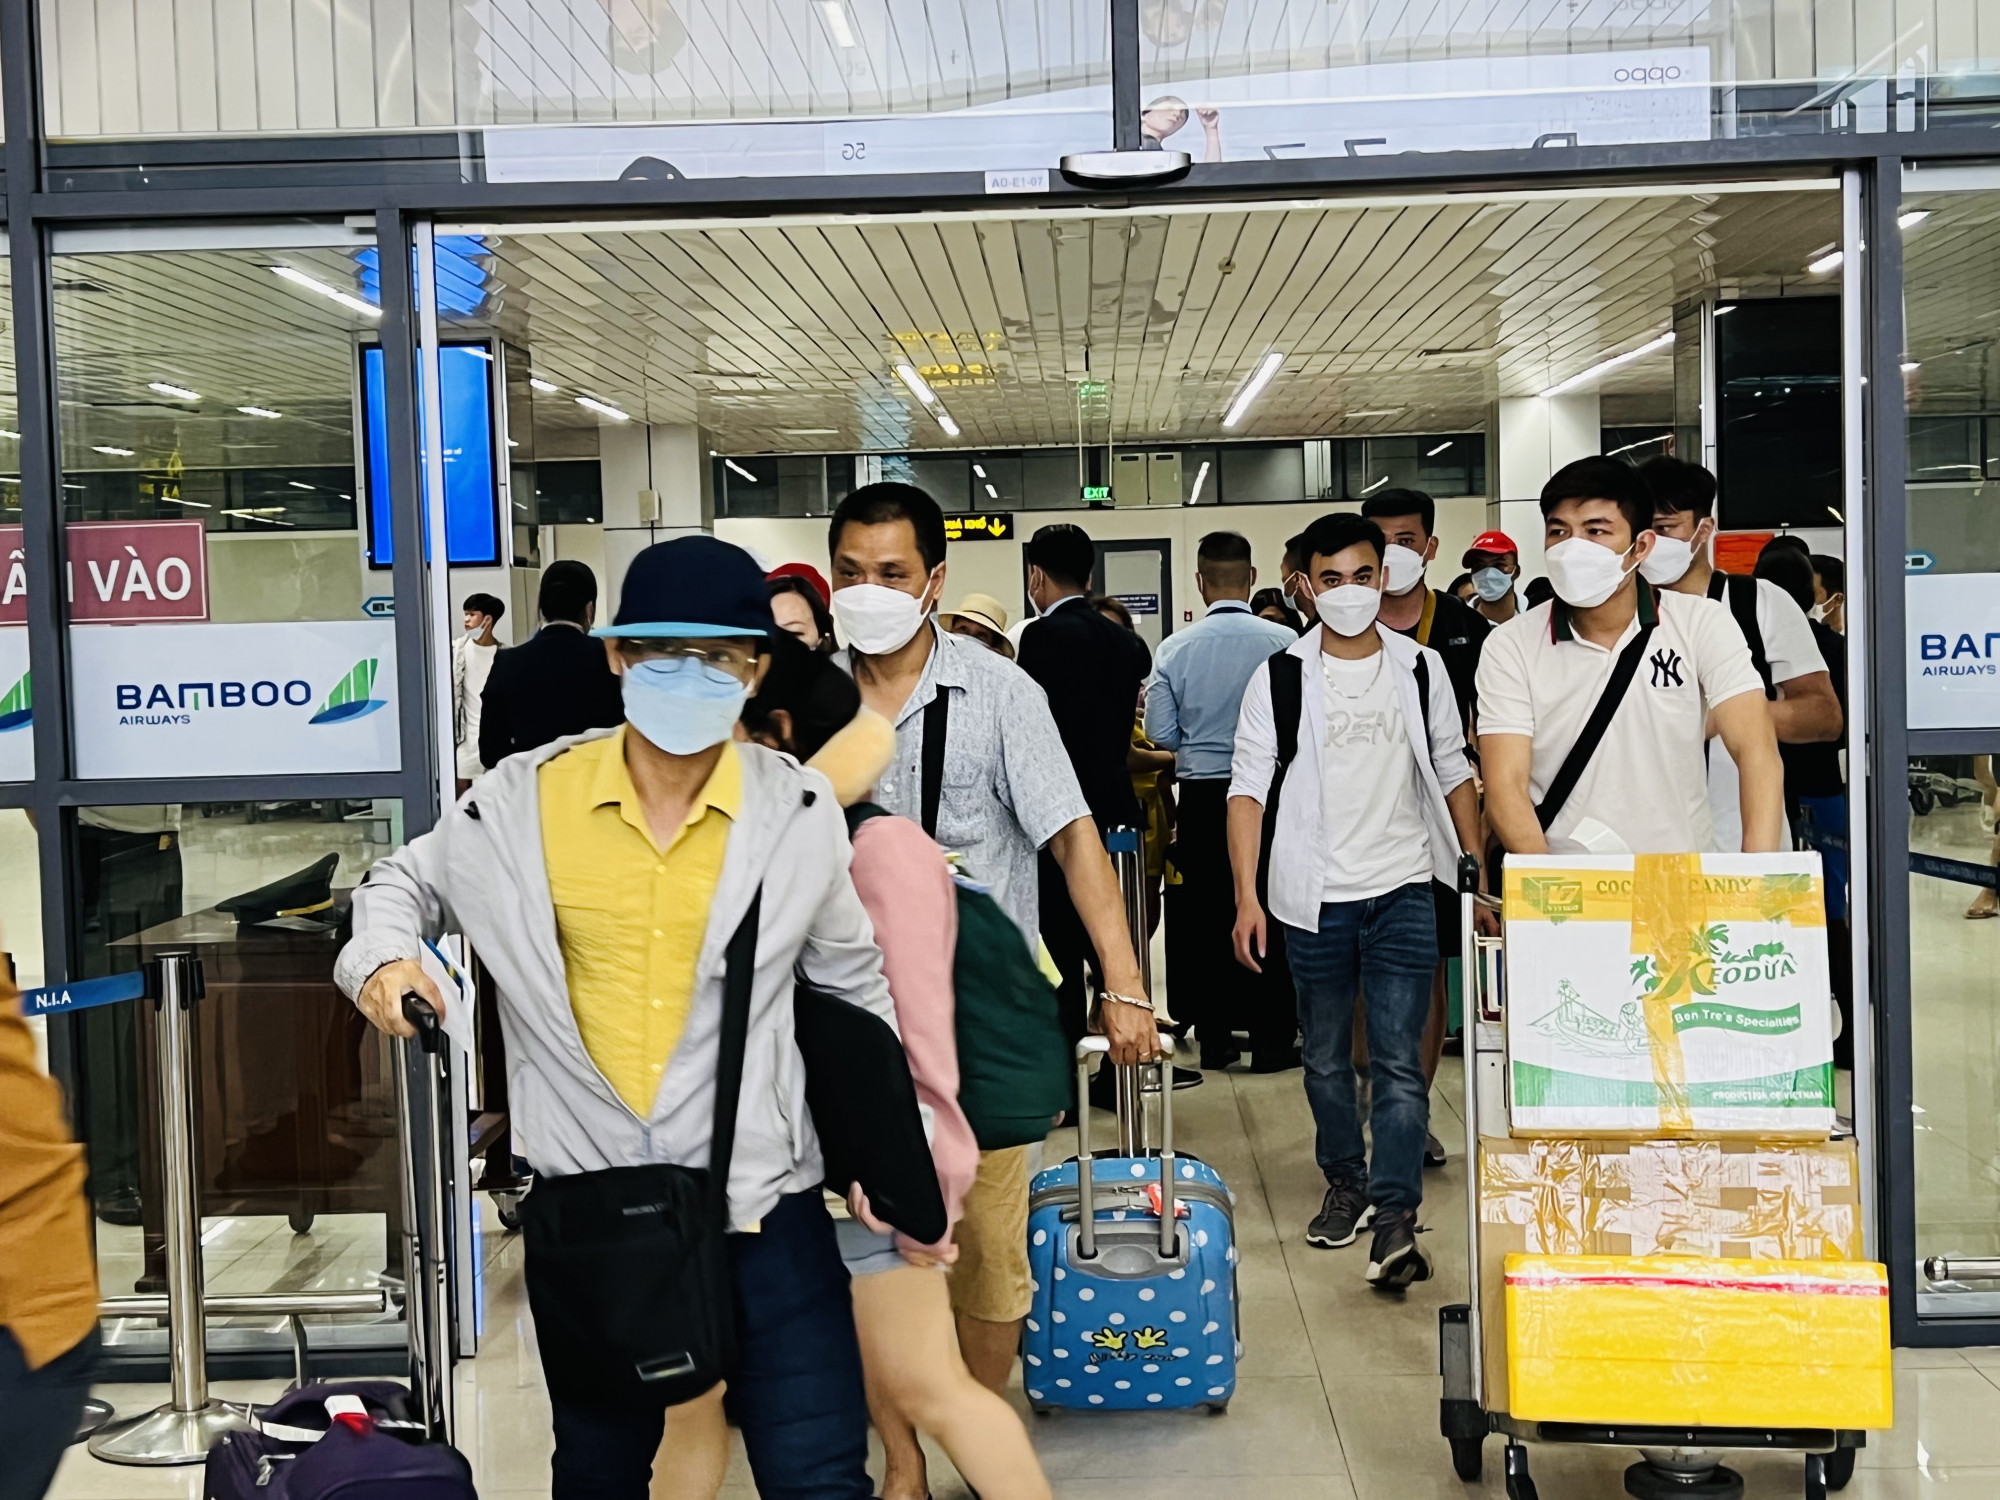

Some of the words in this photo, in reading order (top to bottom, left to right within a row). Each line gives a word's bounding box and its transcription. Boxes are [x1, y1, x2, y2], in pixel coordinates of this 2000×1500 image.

[1084, 486, 1109, 499] EXIT
[88, 545, 192, 602] VÀO
[1650, 648, 1684, 688] NY
[1922, 664, 1997, 676] AIRWAYS
[116, 680, 312, 711] BAMBOO
[119, 714, 191, 726] AIRWAYS
[1735, 1013, 1800, 1027] Specialties
